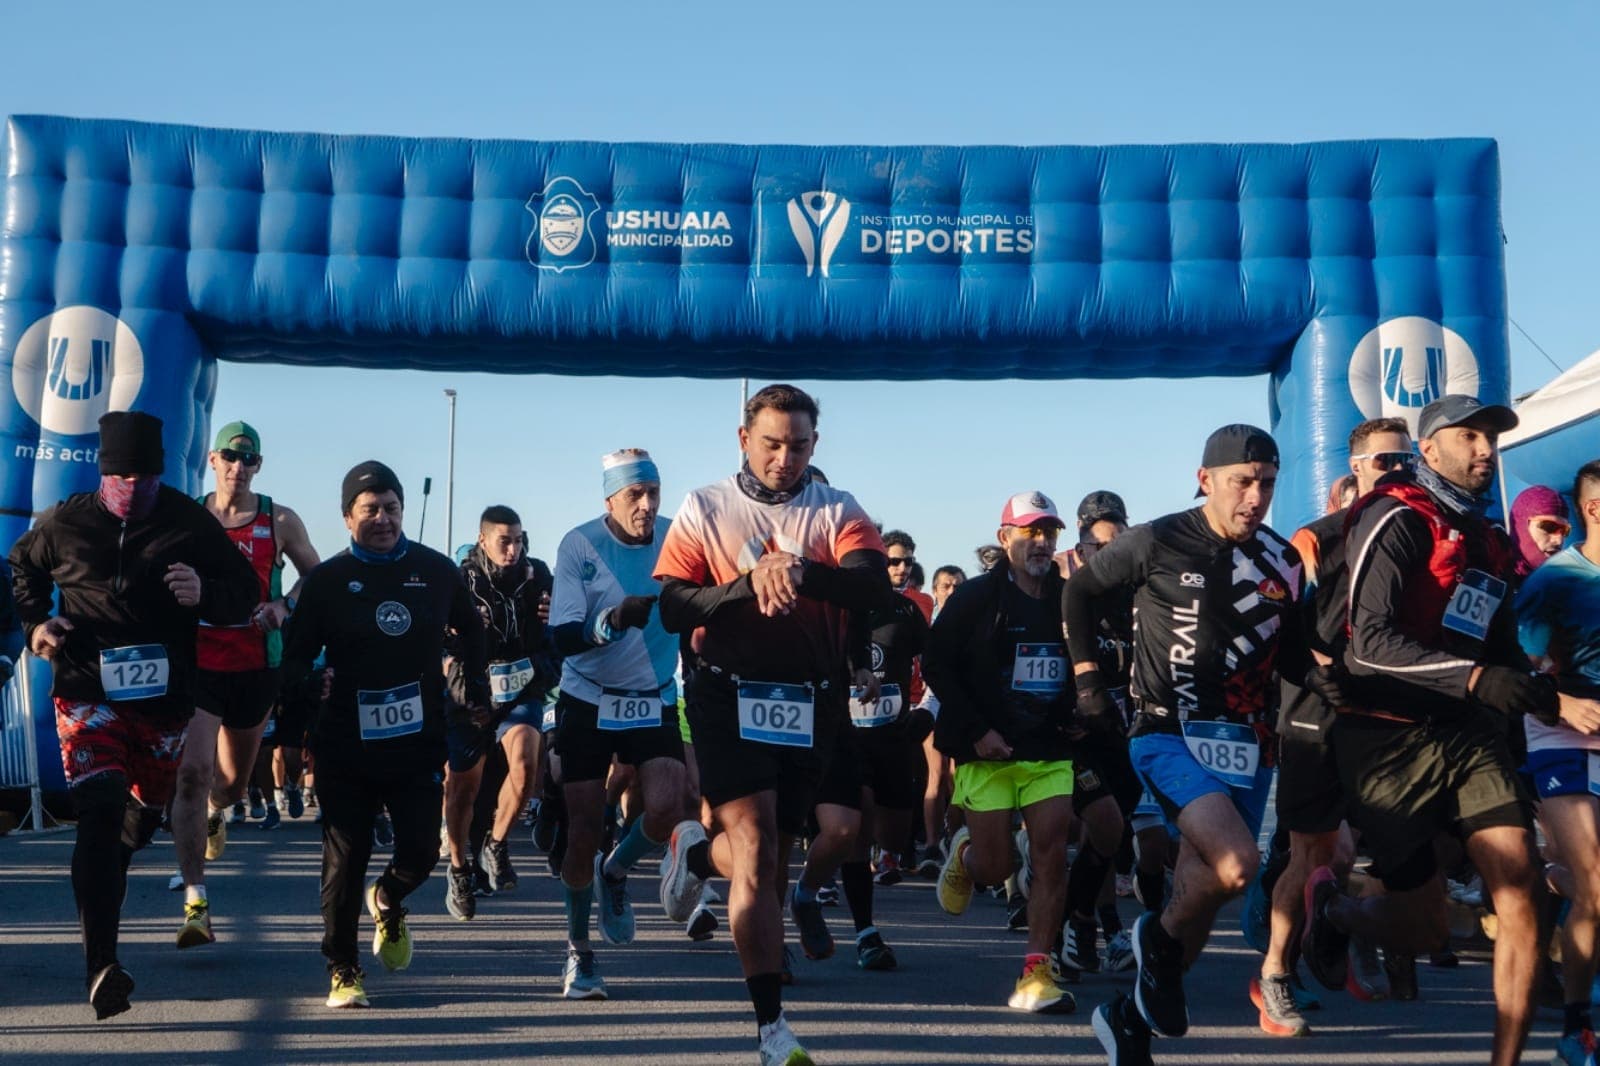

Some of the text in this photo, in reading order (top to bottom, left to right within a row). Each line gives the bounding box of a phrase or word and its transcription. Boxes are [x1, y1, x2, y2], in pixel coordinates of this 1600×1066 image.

[606, 211, 731, 230] USHUAIA
[861, 215, 1033, 226] INSTITUTO MUNICIPAL DE
[607, 234, 733, 247] MUNICIPALIDAD
[861, 229, 1033, 254] DEPORTES
[15, 443, 55, 461] más
[113, 662, 159, 687] 122
[1026, 659, 1059, 679] 118
[500, 672, 528, 692] 036
[370, 702, 414, 727] 106
[611, 699, 650, 719] 180
[751, 702, 802, 730] 062
[1198, 742, 1249, 772] 085
